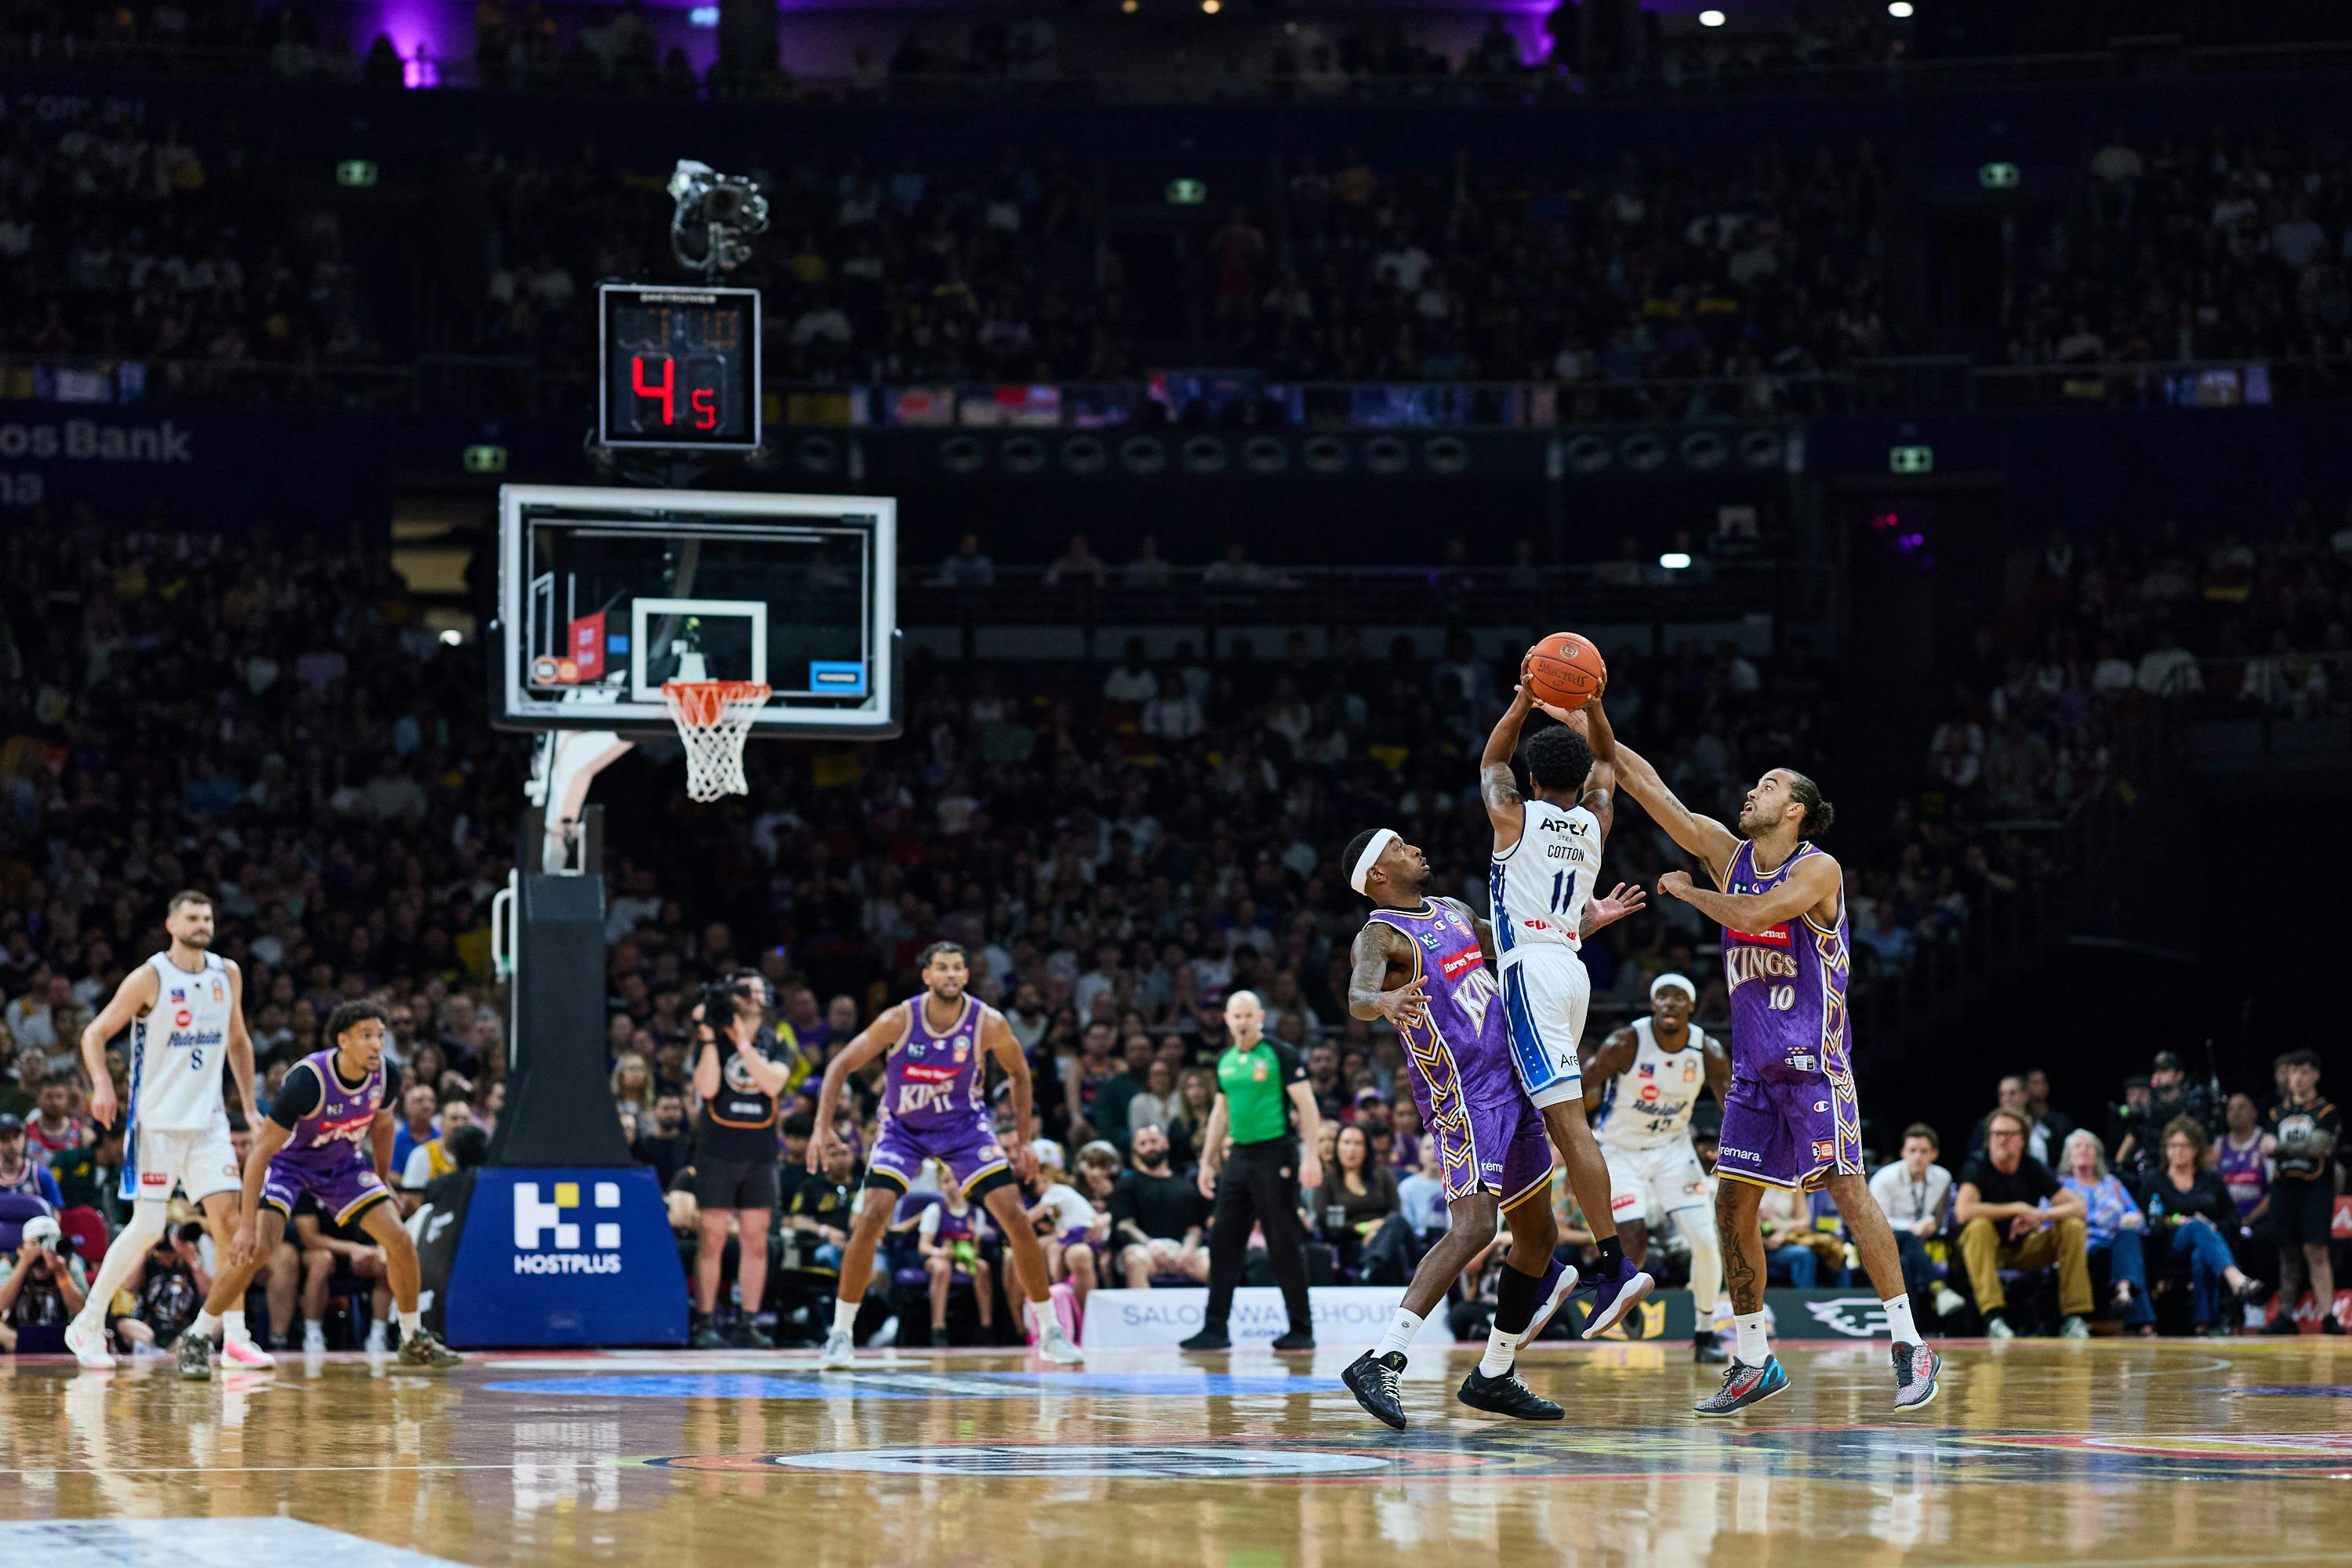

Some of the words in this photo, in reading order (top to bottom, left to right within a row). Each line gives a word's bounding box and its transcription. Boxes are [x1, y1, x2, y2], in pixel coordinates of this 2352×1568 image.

[64, 418, 194, 463] Bank
[1557, 834, 1577, 843] STEEL
[1548, 844, 1584, 862] COTTON
[1549, 867, 1577, 916] 11
[1726, 946, 1798, 996] KINGS
[1768, 984, 1795, 1011] 10
[514, 1254, 622, 1275] HOSTPLUS
